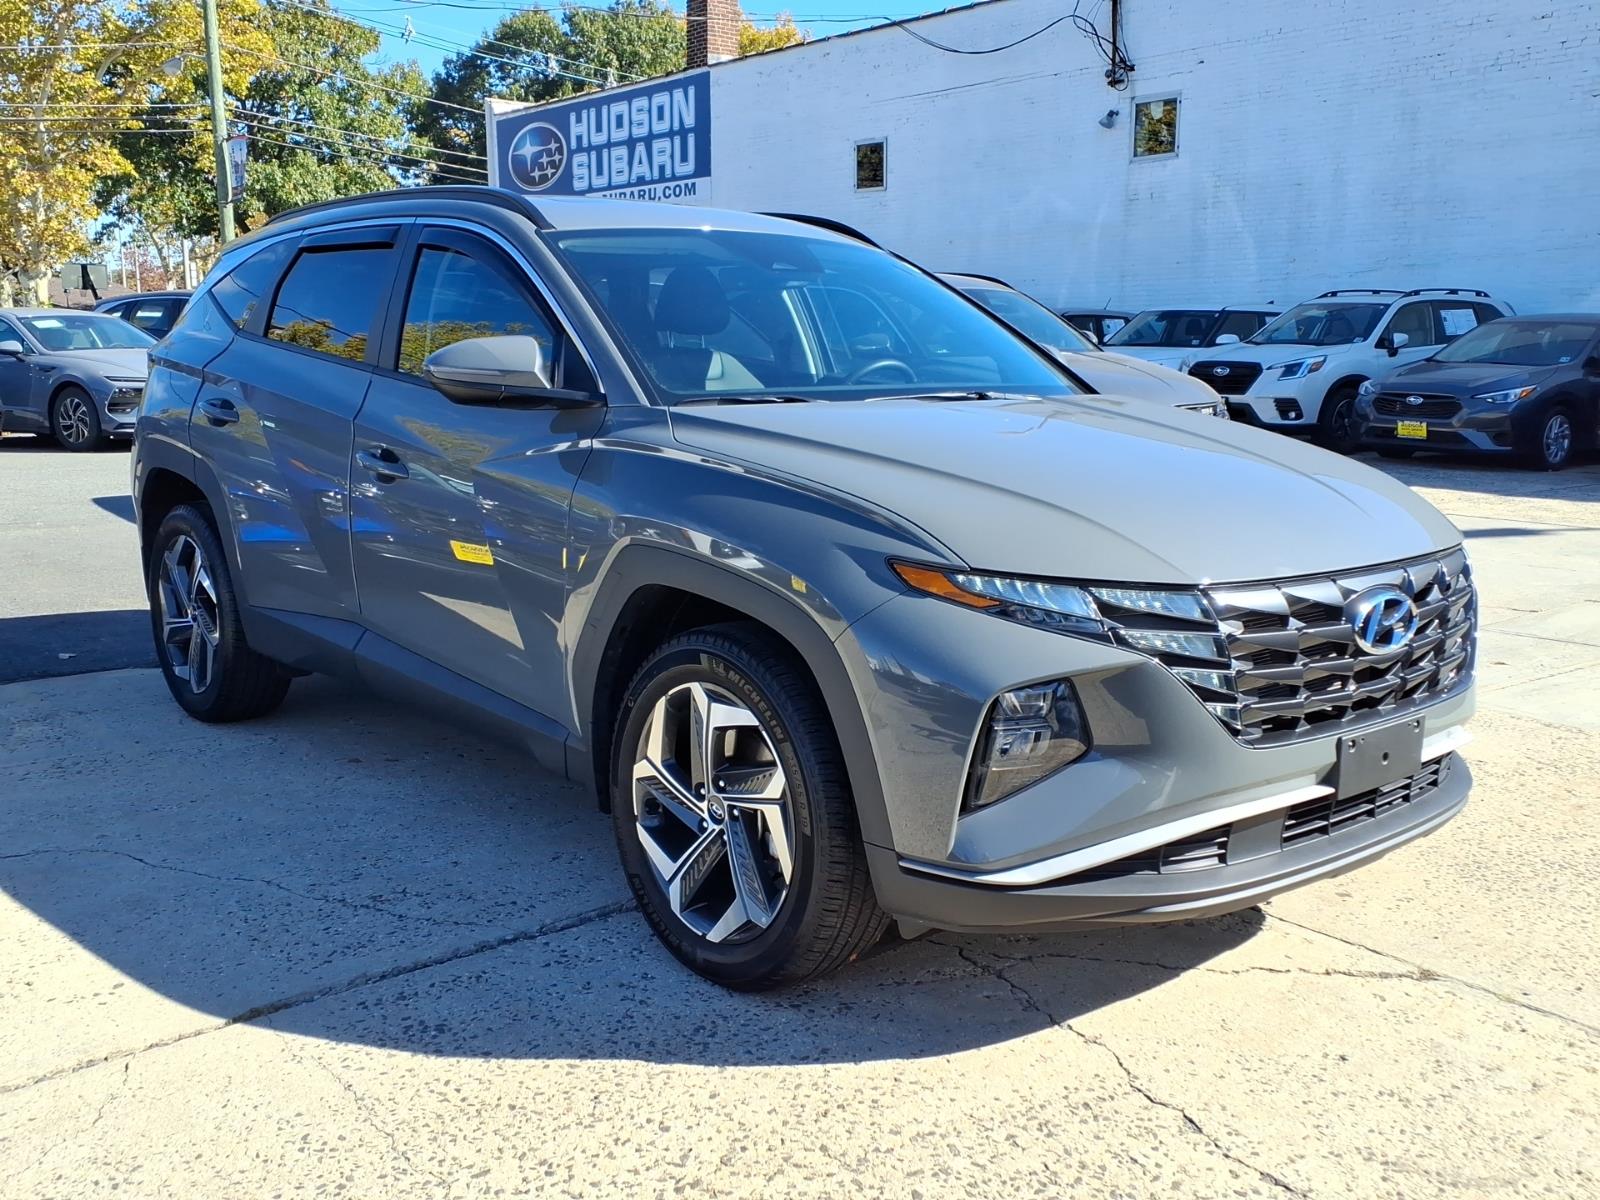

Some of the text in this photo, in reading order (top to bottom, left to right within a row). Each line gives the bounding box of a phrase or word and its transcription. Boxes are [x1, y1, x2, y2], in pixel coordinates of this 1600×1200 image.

[569, 85, 696, 150] HUDSON
[571, 133, 696, 192] SUBARU
[727, 670, 785, 740] MICHELIN
